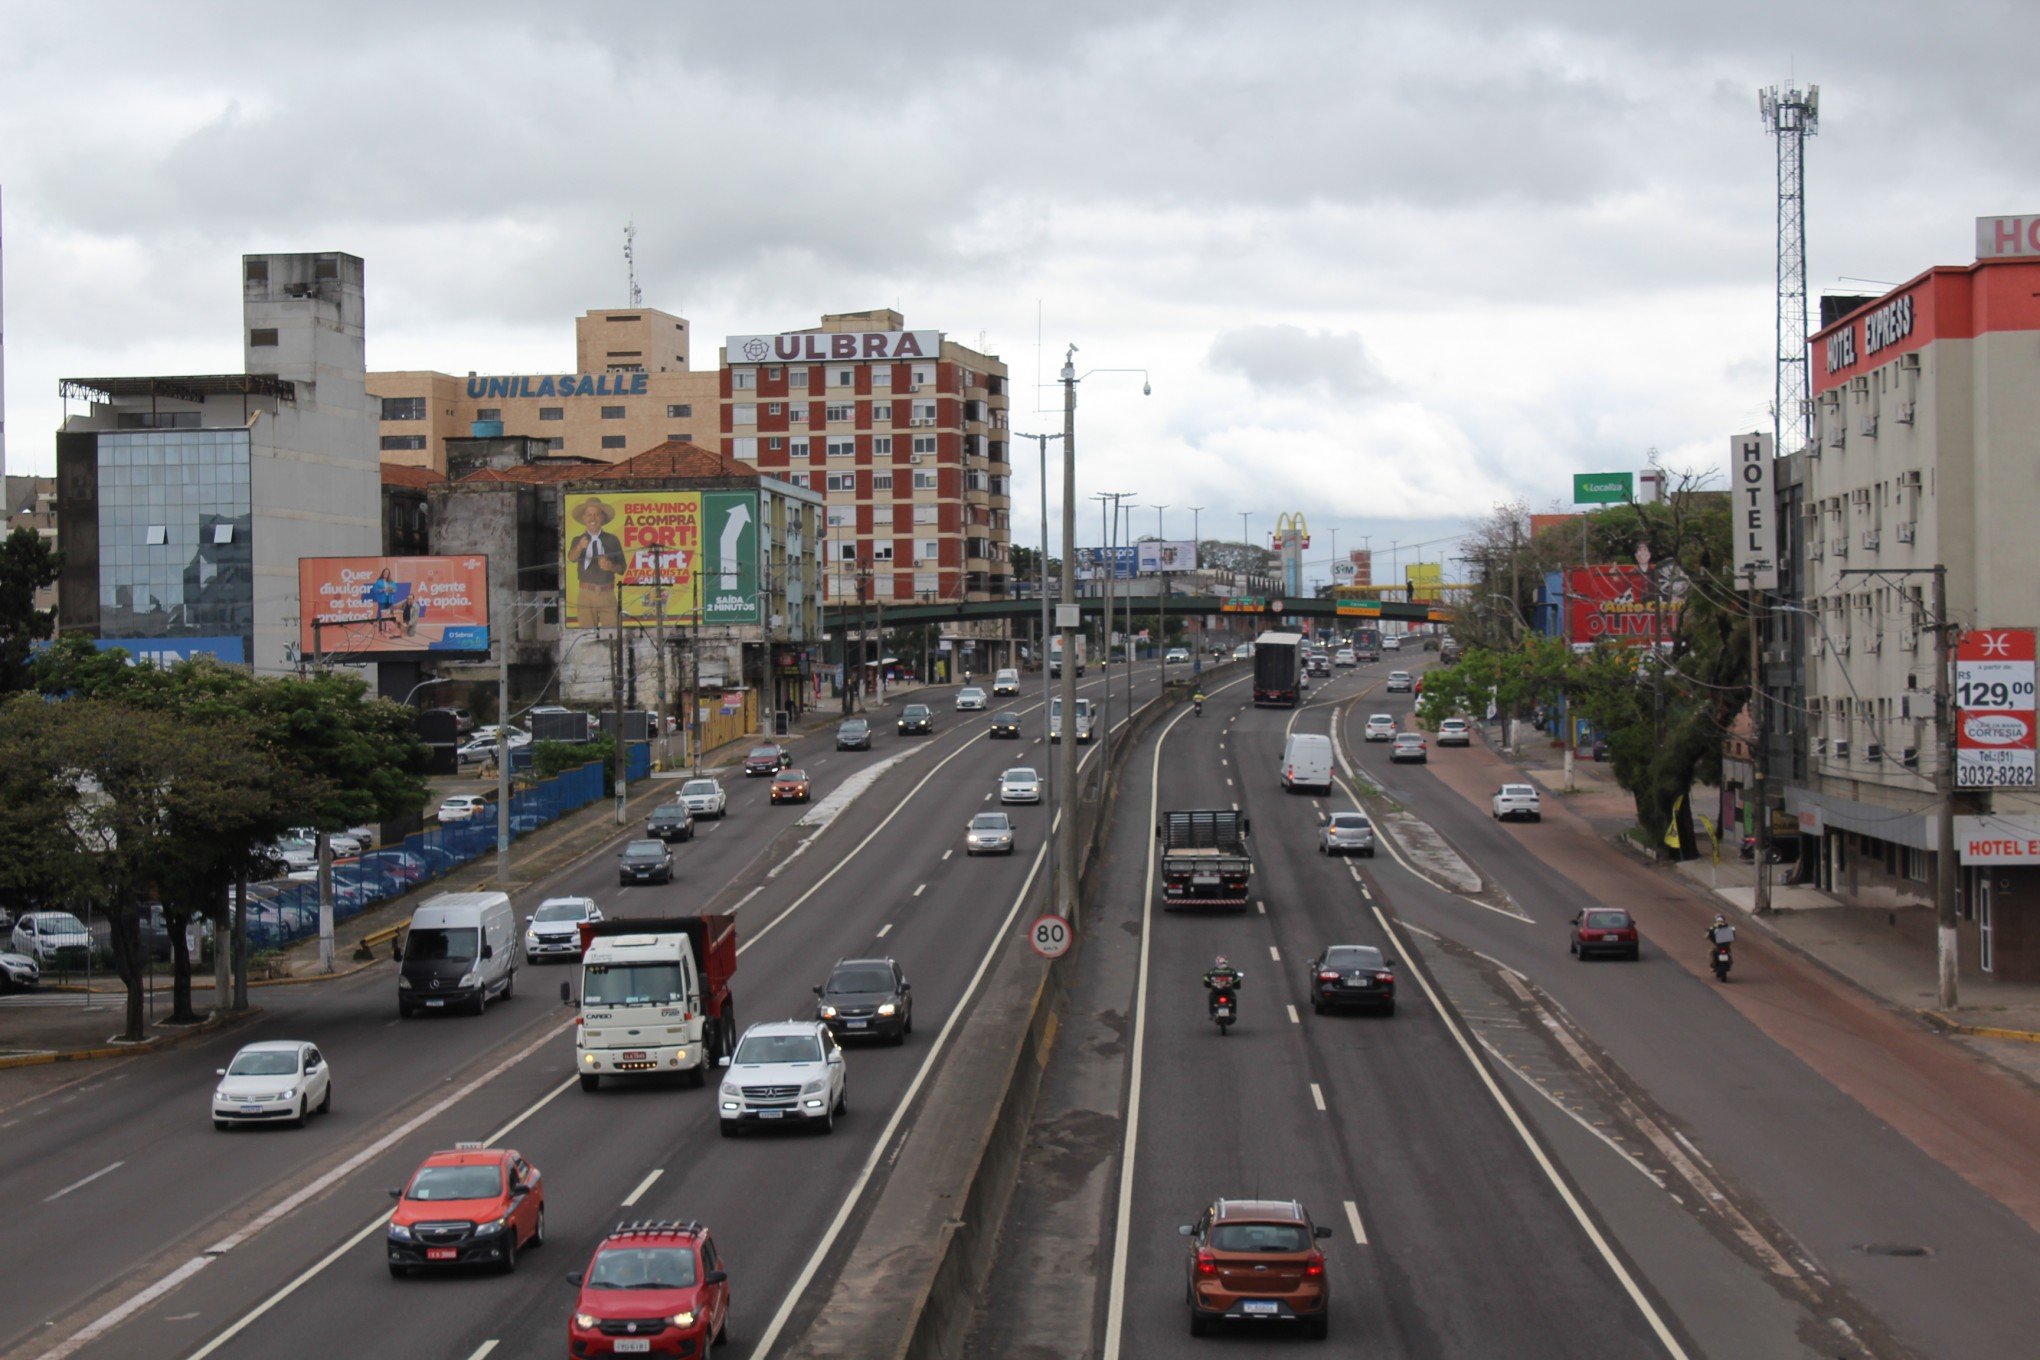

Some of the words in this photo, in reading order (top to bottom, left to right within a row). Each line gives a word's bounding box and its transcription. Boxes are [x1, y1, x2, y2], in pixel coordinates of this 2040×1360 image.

[1827, 325, 1857, 374] HOTEL
[1865, 294, 1913, 357] EXPRESS
[775, 332, 923, 360] ULBRA
[467, 374, 649, 398] UNILASALLE
[1743, 442, 1762, 552] HOTEL
[624, 502, 697, 514] BEM-VINDO
[624, 515, 634, 526] A
[637, 515, 696, 526] COMPRA
[624, 526, 697, 547] FORT!
[635, 550, 687, 569] Fort
[341, 568, 373, 583] Quer
[625, 568, 690, 577] ATACDISTA
[418, 582, 427, 592] A
[430, 582, 466, 595] gente
[329, 600, 344, 609] os
[348, 599, 373, 609] teus
[418, 597, 430, 607] te
[433, 596, 472, 609] apoia.
[716, 594, 744, 604] SAÍDA
[706, 604, 713, 612] 2
[714, 603, 755, 612] MINUTOS
[1605, 601, 1644, 613] Auto
[1958, 671, 1971, 679] R$
[1968, 728, 2023, 738] CORTESIA
[1960, 766, 2034, 786] 3032-8282
[1969, 841, 2023, 856] HOTEL
[2027, 841, 2040, 856] E
[1037, 925, 1064, 943] 80
